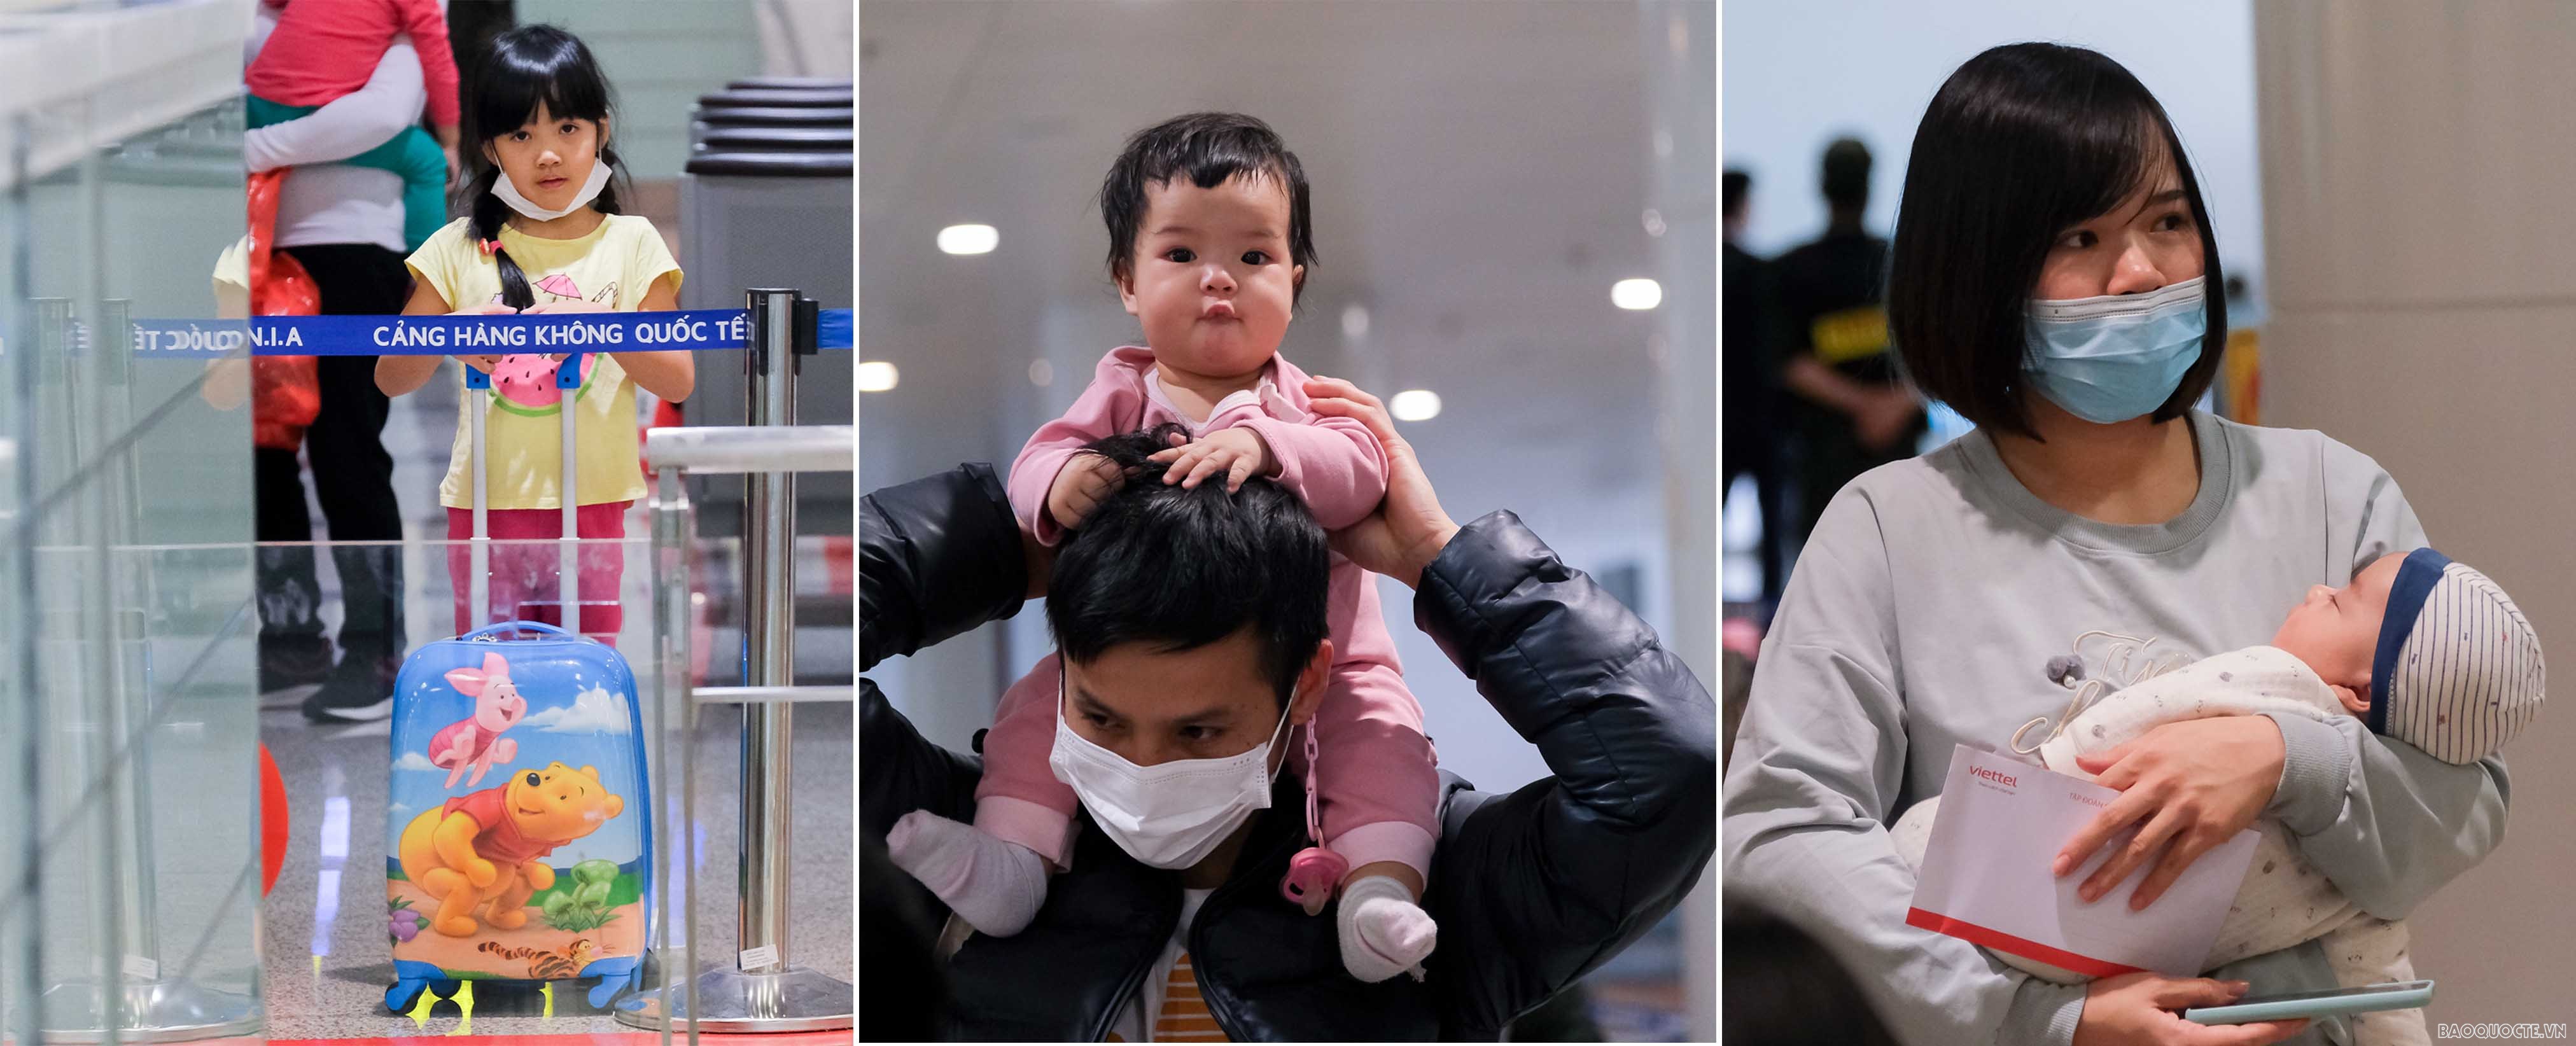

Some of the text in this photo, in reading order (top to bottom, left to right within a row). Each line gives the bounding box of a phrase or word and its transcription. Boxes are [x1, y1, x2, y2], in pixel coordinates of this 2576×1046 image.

[248, 326, 304, 347] N.I.A
[374, 312, 745, 346] CẢNG HÀNG KHÔNG QUỐC TẾ
[1970, 765, 2017, 788] viettel
